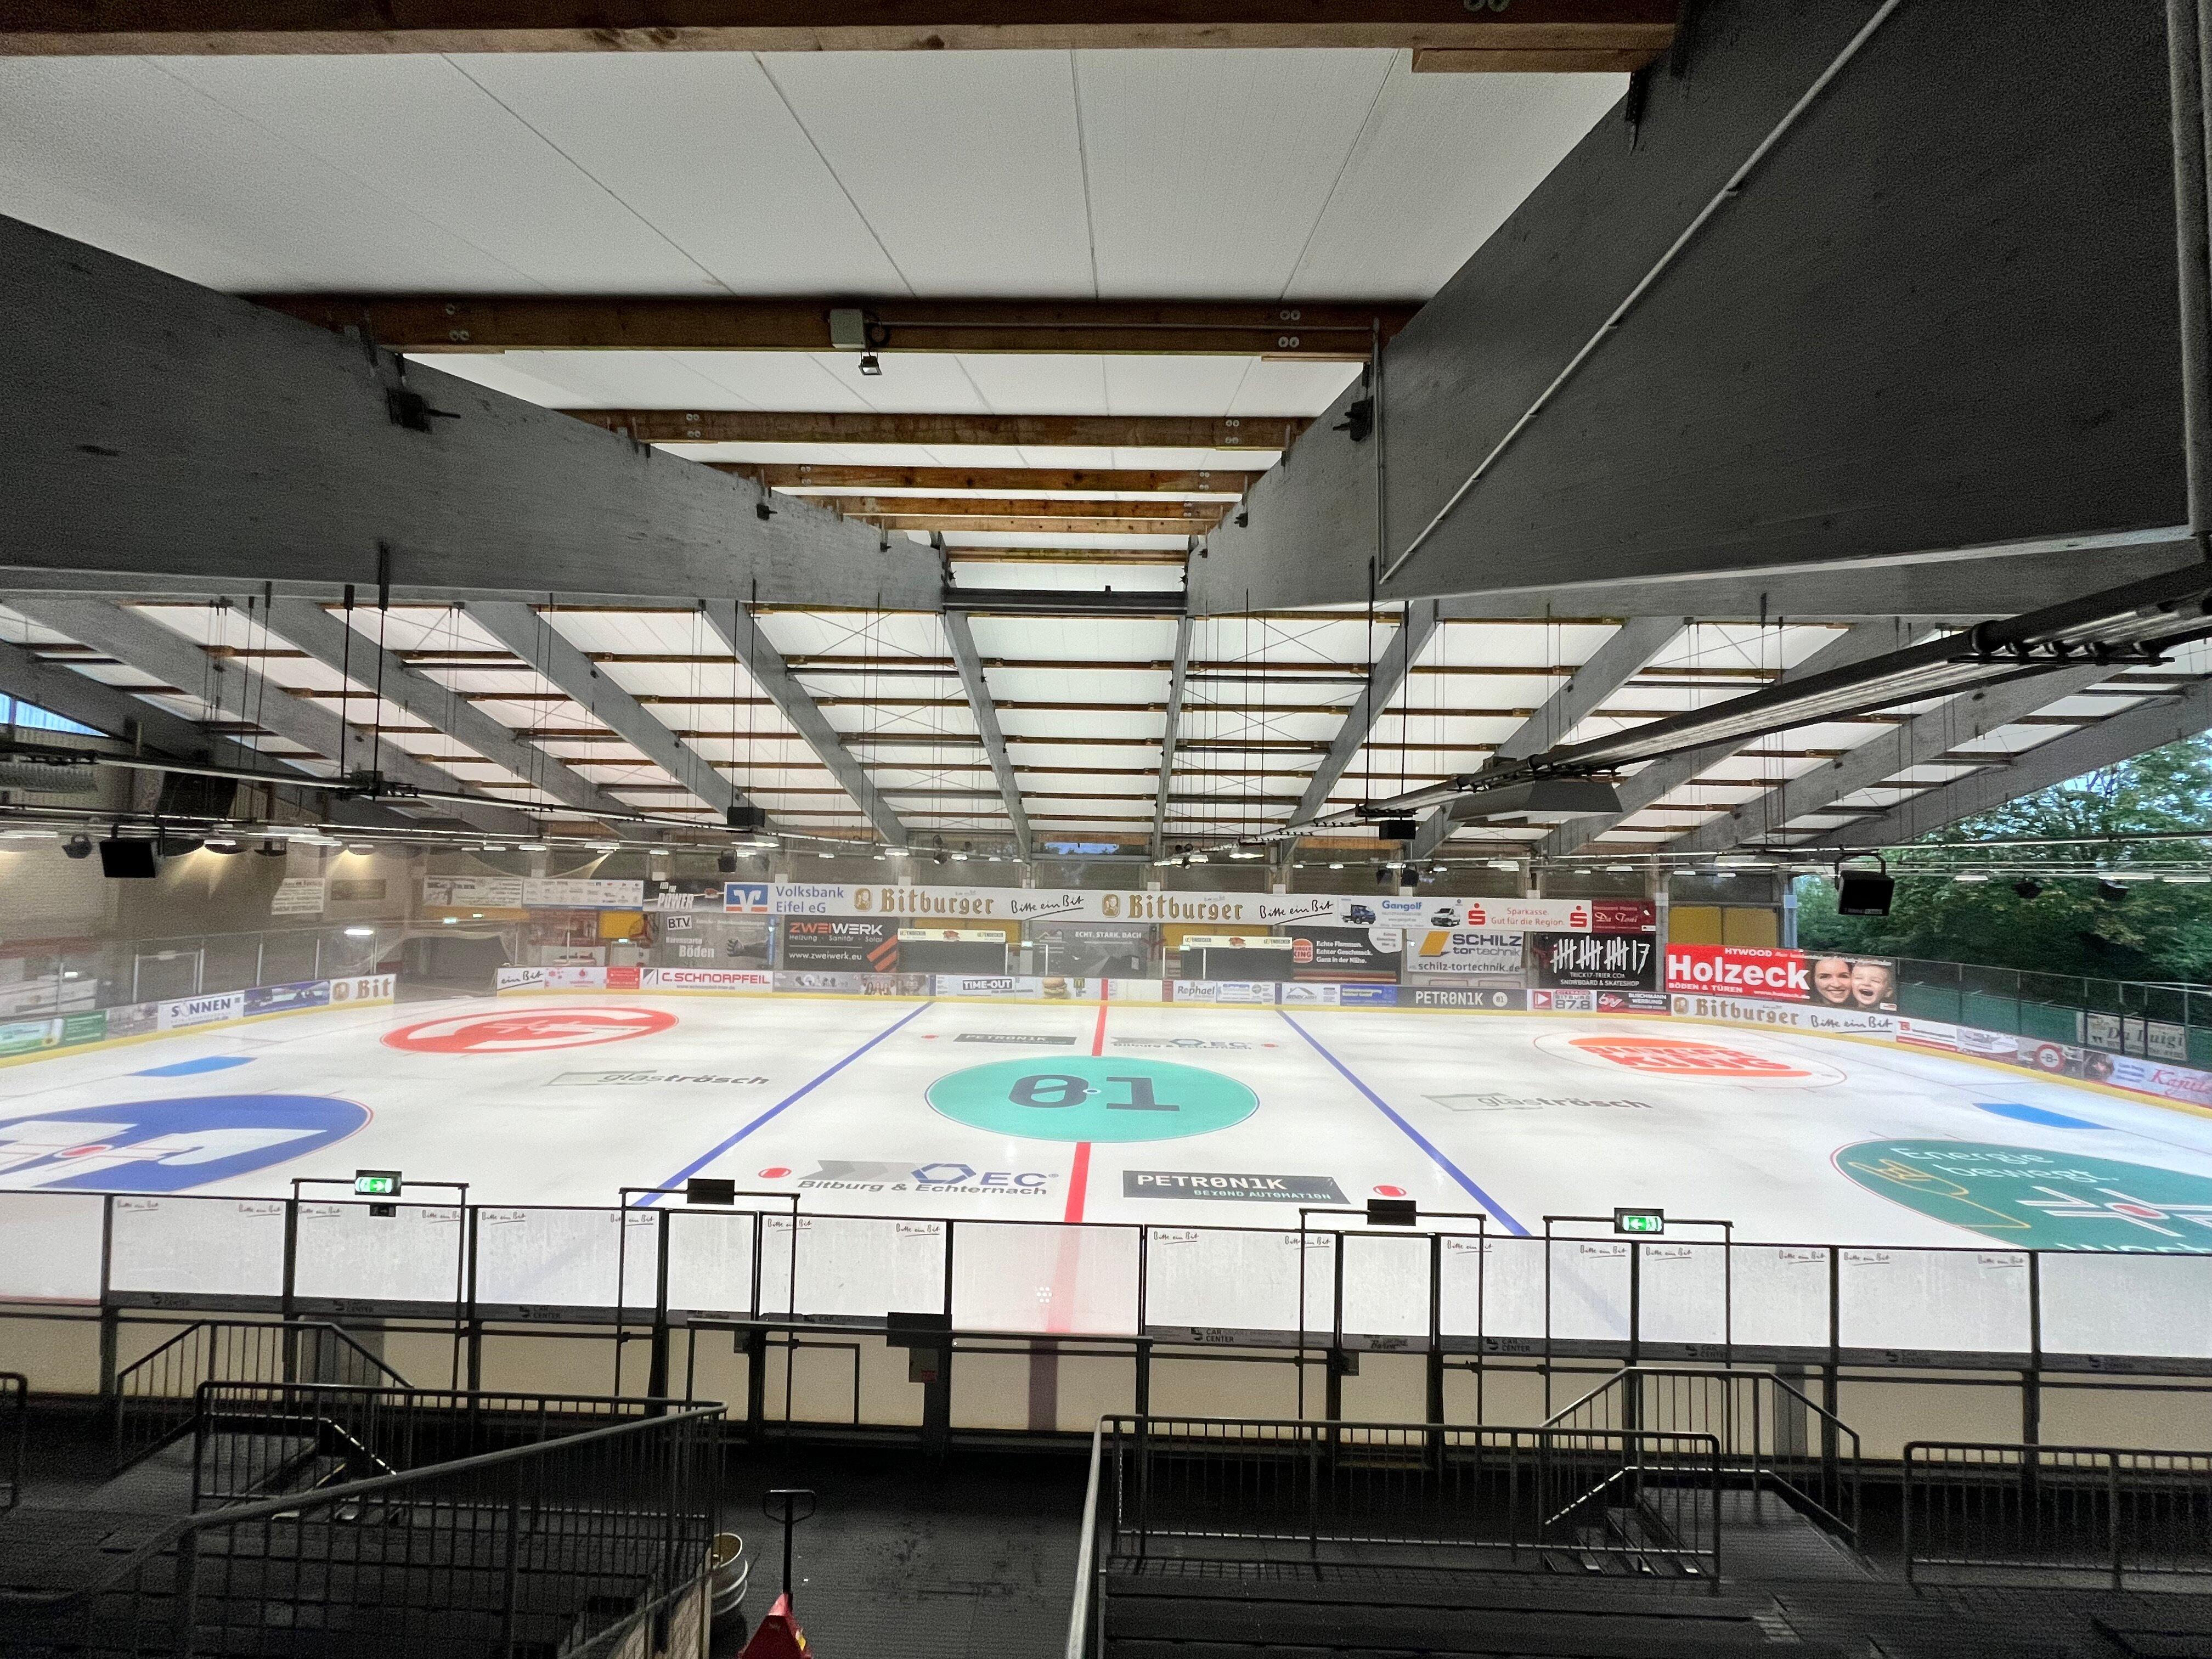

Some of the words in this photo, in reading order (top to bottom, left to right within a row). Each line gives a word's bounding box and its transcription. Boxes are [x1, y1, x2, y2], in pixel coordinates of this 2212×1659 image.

[776, 886, 844, 898] Volksbank
[658, 893, 694, 909] POWER
[776, 901, 803, 912] Eifel
[809, 902, 826, 913] eG
[879, 888, 994, 915] Bitburger
[1011, 900, 1037, 913] Bitte
[1041, 900, 1059, 910] ein
[1063, 895, 1084, 906] Bit
[1127, 894, 1243, 920] Bitburger
[1382, 900, 1422, 912] Gangolf
[1260, 905, 1286, 918] Bitte
[1290, 907, 1309, 915] ein
[1312, 900, 1333, 912] Bit
[1521, 917, 1532, 926] die
[789, 922, 883, 935] ZWEIWERK
[1453, 934, 1522, 946] SCHILZ
[679, 945, 715, 958] Böden
[789, 951, 862, 960] www.zweiwerk.eu
[1453, 947, 1520, 956] tortechnik
[1725, 948, 1772, 957] HYWOOD
[1418, 962, 1520, 972] schilz-tortechnik.de
[1668, 954, 1810, 990] Holzeck
[522, 970, 543, 981] Bit
[964, 980, 1011, 989] TIME-OUT
[1712, 984, 1742, 993] TÜREN
[1555, 1000, 1590, 1009] 87.8
[1695, 997, 1799, 1025] Bitburger
[1810, 1015, 1840, 1028] Bitte
[1844, 1019, 1866, 1028] ein
[1869, 1015, 1893, 1028] Bit
[1890, 1148, 2054, 1165] Energie
[798, 1181, 885, 1192] Bitburg
[891, 1183, 906, 1192] &
[915, 1184, 1047, 1195] Echternach
[611, 1214, 621, 1223] Bit
[1484, 1241, 1493, 1249] it
